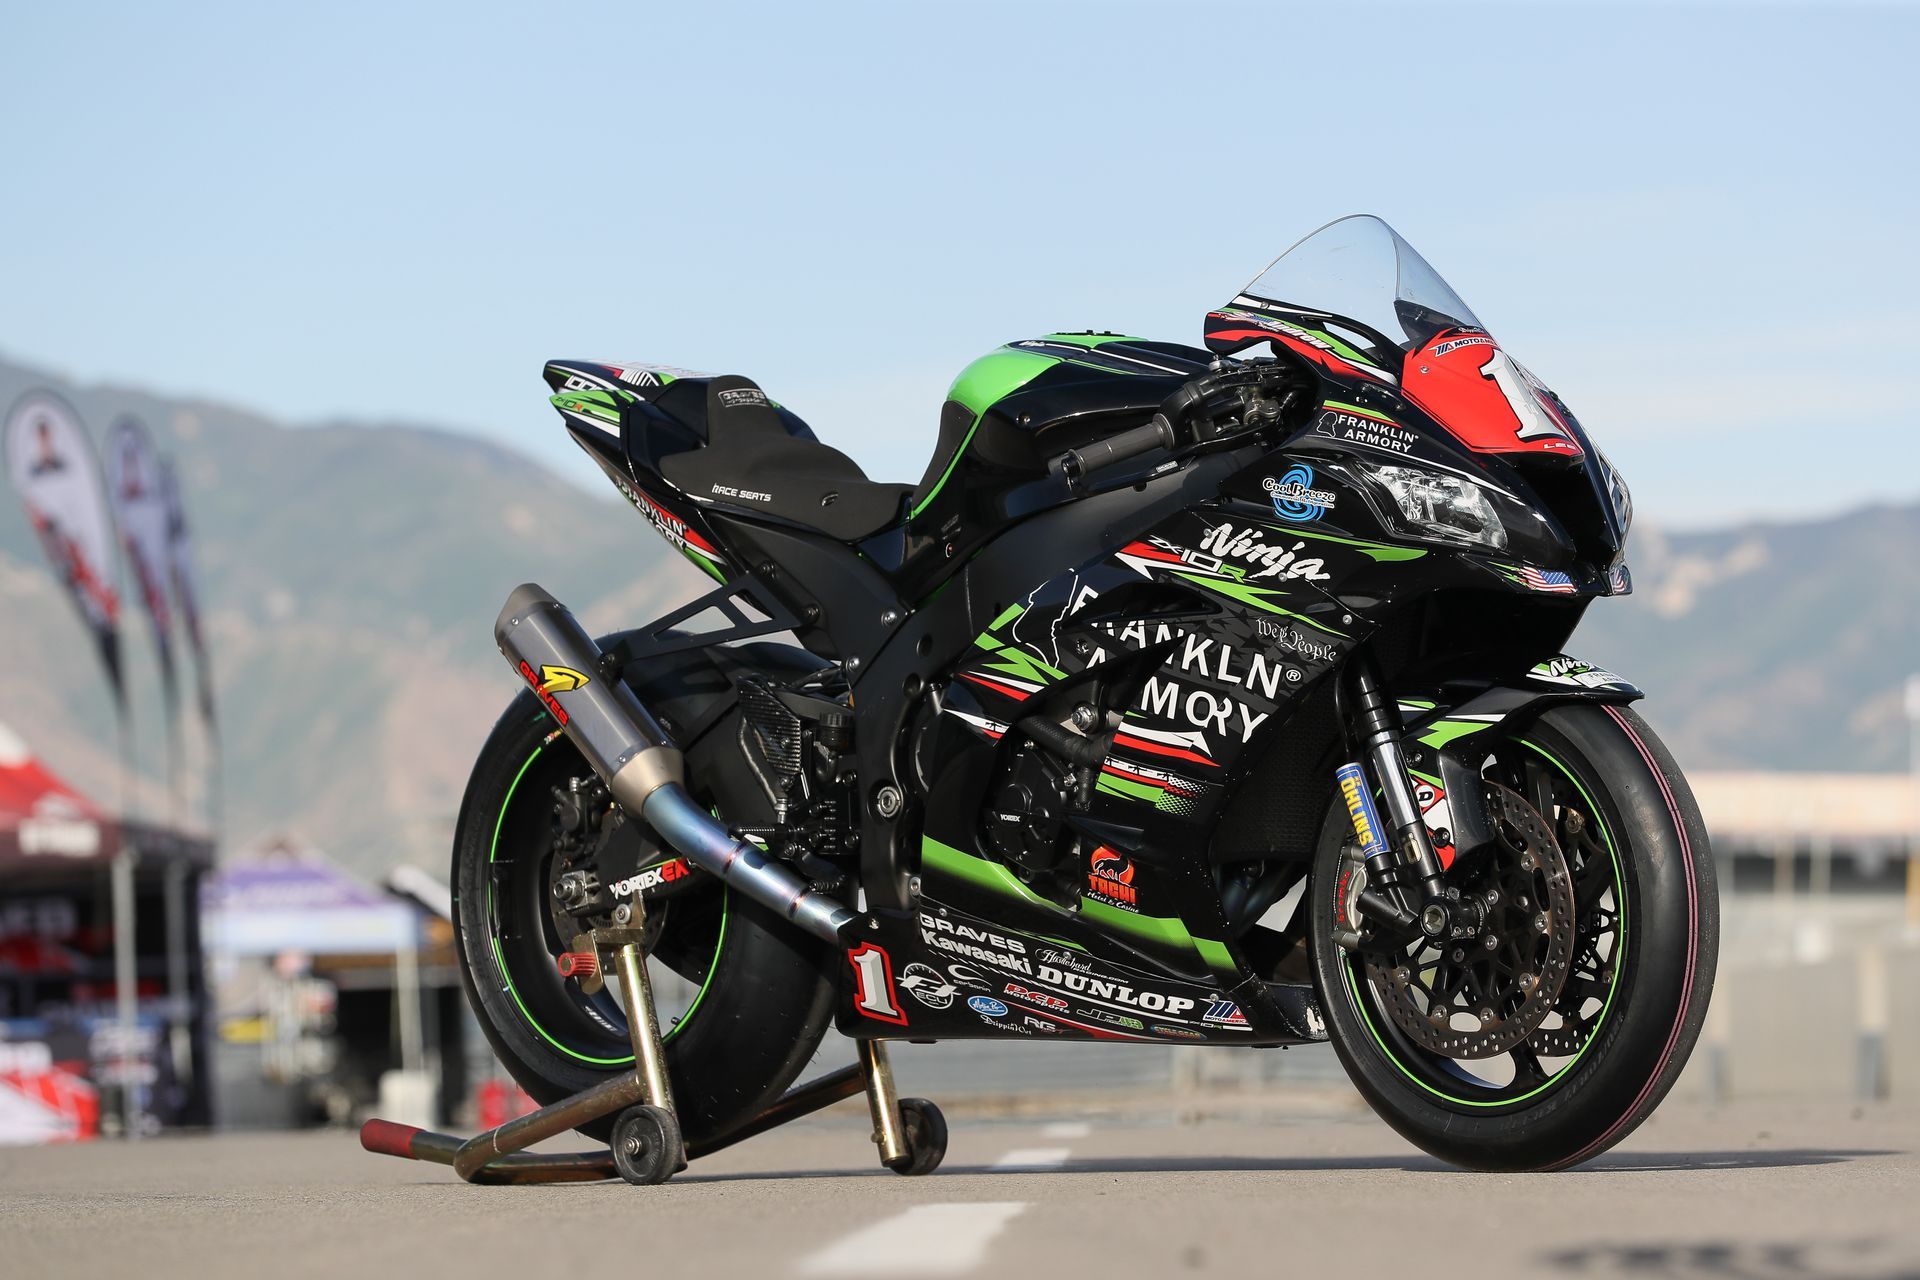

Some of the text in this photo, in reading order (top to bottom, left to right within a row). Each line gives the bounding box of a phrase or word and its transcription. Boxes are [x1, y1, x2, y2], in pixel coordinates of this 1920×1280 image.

[1480, 348, 1568, 439] 1
[1338, 414, 1416, 443] FRANKLIN
[1344, 429, 1411, 453] ARMORY
[711, 483, 772, 502] RACE SEATS
[1200, 523, 1330, 580] Ninja
[1256, 617, 1277, 638] We
[1281, 631, 1336, 661] People
[919, 912, 1026, 953] GRAVES
[921, 928, 1033, 975] Kawasaki
[850, 944, 904, 1021] 1
[1003, 990, 1070, 1014] Motorsports
[1037, 965, 1195, 1015] DUNLOP
